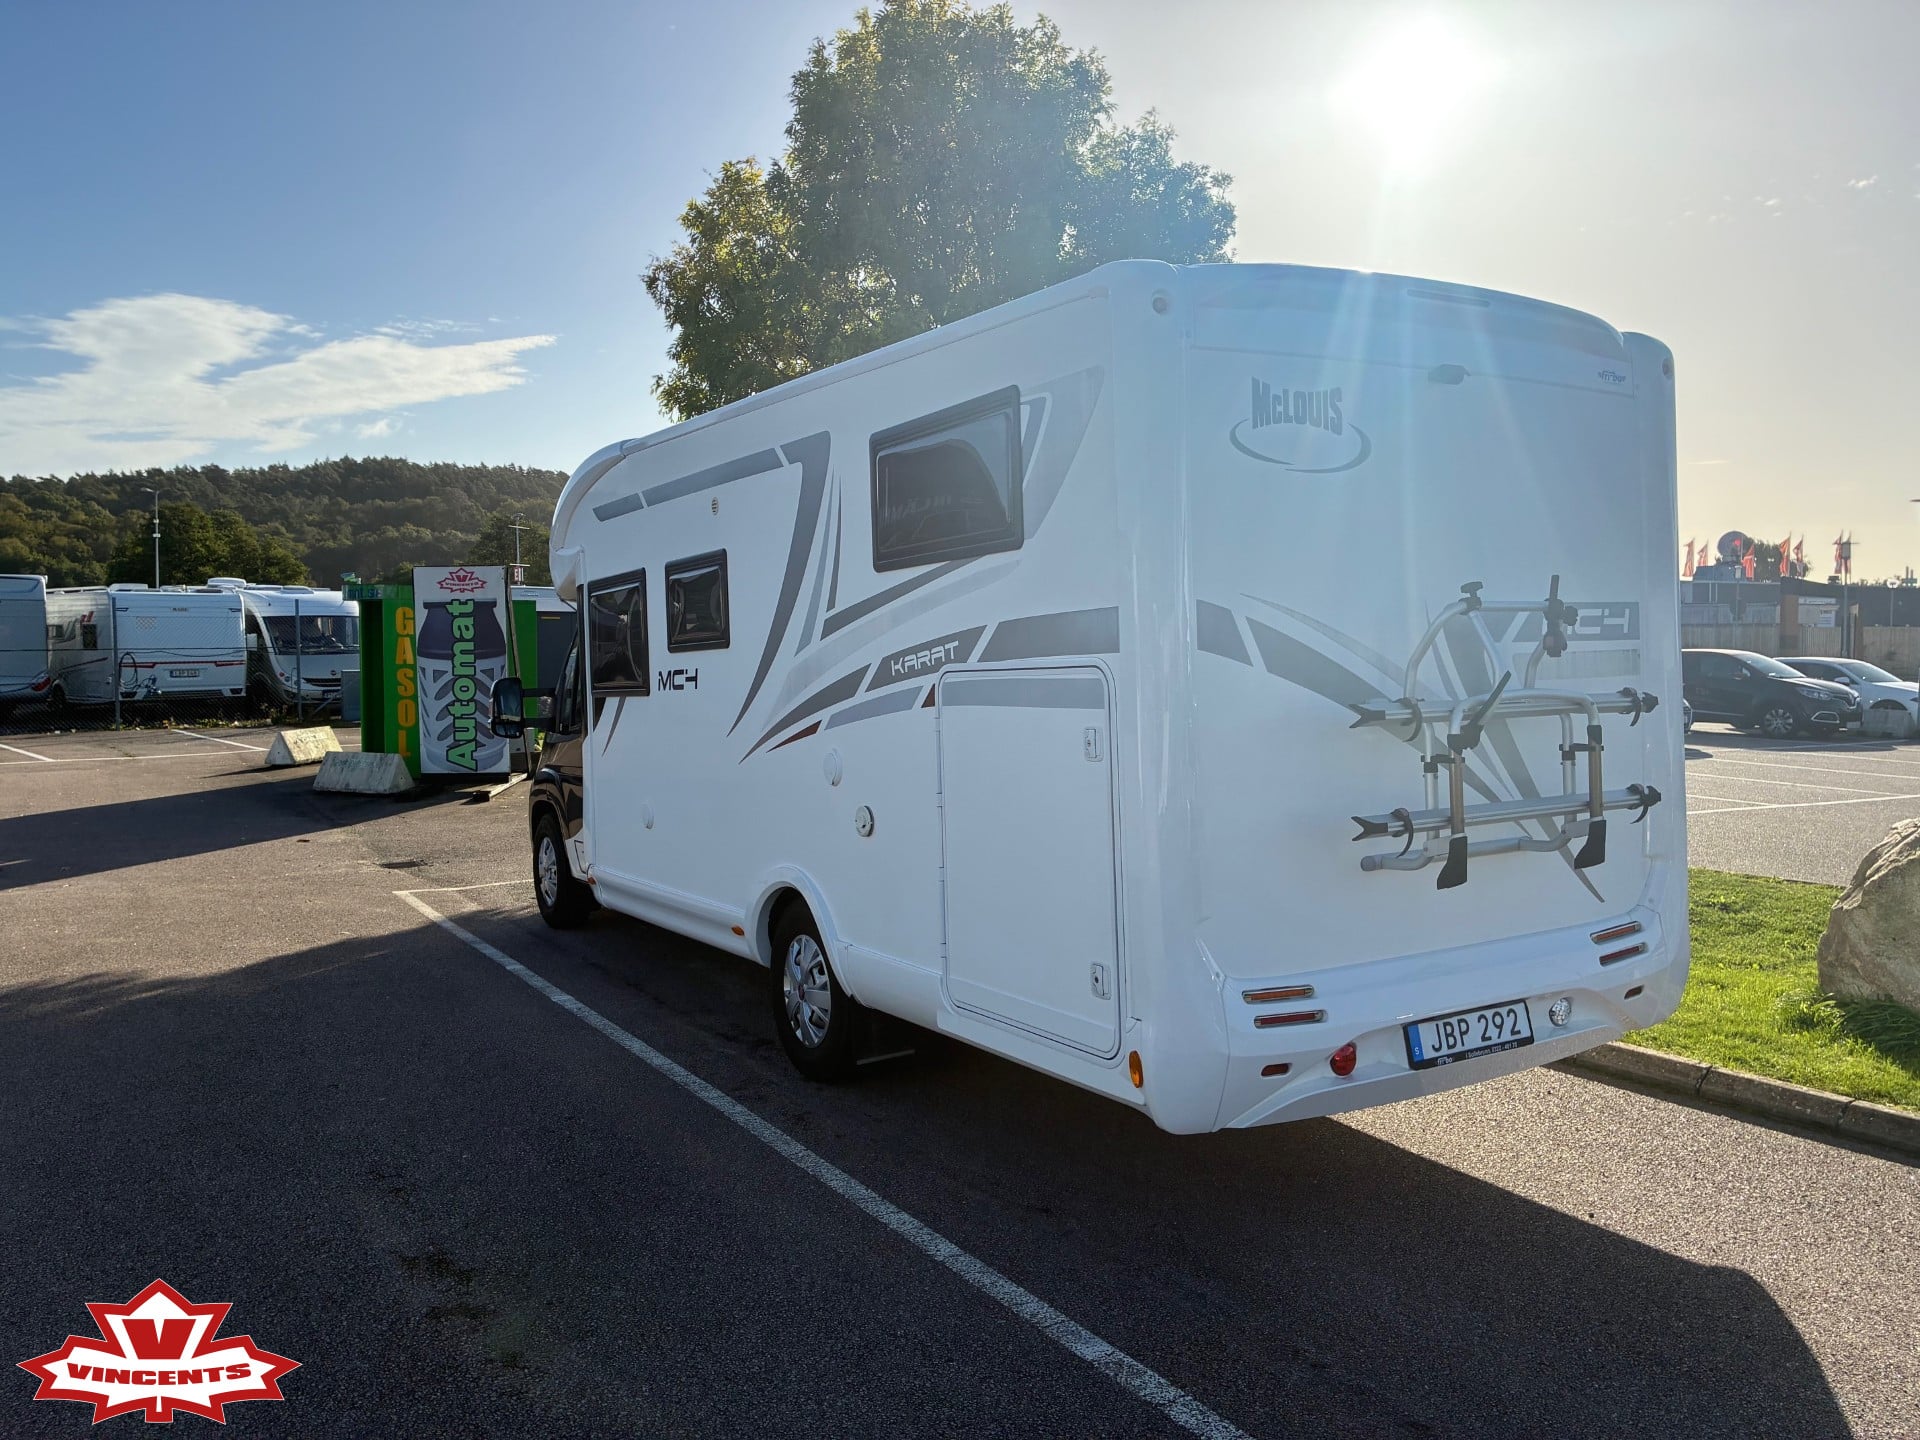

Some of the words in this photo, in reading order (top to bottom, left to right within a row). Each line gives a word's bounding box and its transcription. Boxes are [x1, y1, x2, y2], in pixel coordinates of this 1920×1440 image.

[1251, 376, 1343, 436] McLOUIS
[658, 668, 698, 692] MC4
[891, 641, 959, 676] KARAT
[395, 606, 416, 758] GASOL
[445, 598, 479, 772] Automat
[1414, 1047, 1420, 1055] S
[1432, 1018, 1470, 1052] JBP
[1477, 1008, 1521, 1042] 292
